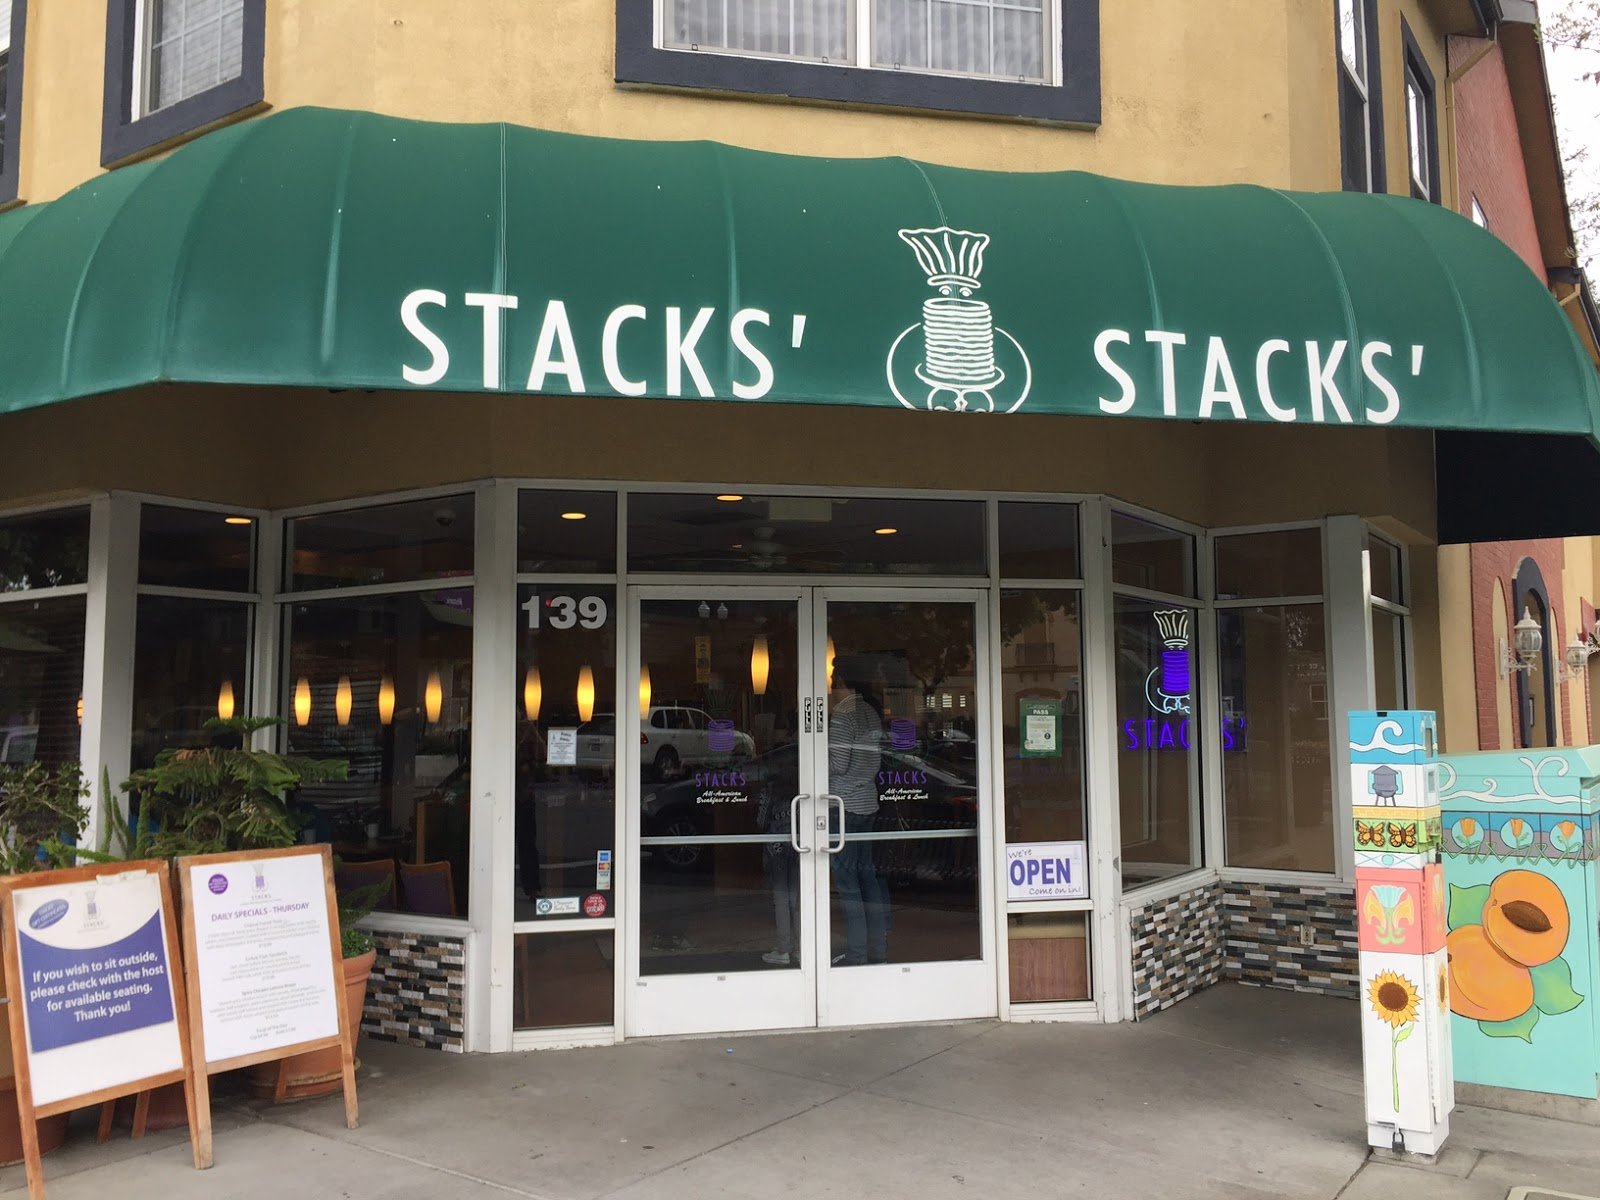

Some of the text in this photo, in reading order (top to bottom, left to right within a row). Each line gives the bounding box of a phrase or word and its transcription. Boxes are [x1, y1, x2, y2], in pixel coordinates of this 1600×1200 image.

[400, 289, 806, 399] STACKS'
[1093, 329, 1423, 424] STACKS'
[522, 596, 607, 629] 139
[695, 772, 746, 787] STACKS
[878, 769, 928, 785] STACKS
[1008, 849, 1032, 858] We're
[1010, 858, 1071, 886] OPEN
[1068, 885, 1081, 893] in!
[211, 912, 233, 922] DAILY
[234, 907, 268, 919] SPECIALS
[273, 902, 310, 913] THURSDAY
[33, 951, 158, 984] If you wish to sit outside,
[30, 965, 164, 1001] please check with the host
[47, 983, 153, 1012] for available seating.
[74, 1000, 131, 1022] Thank you!
